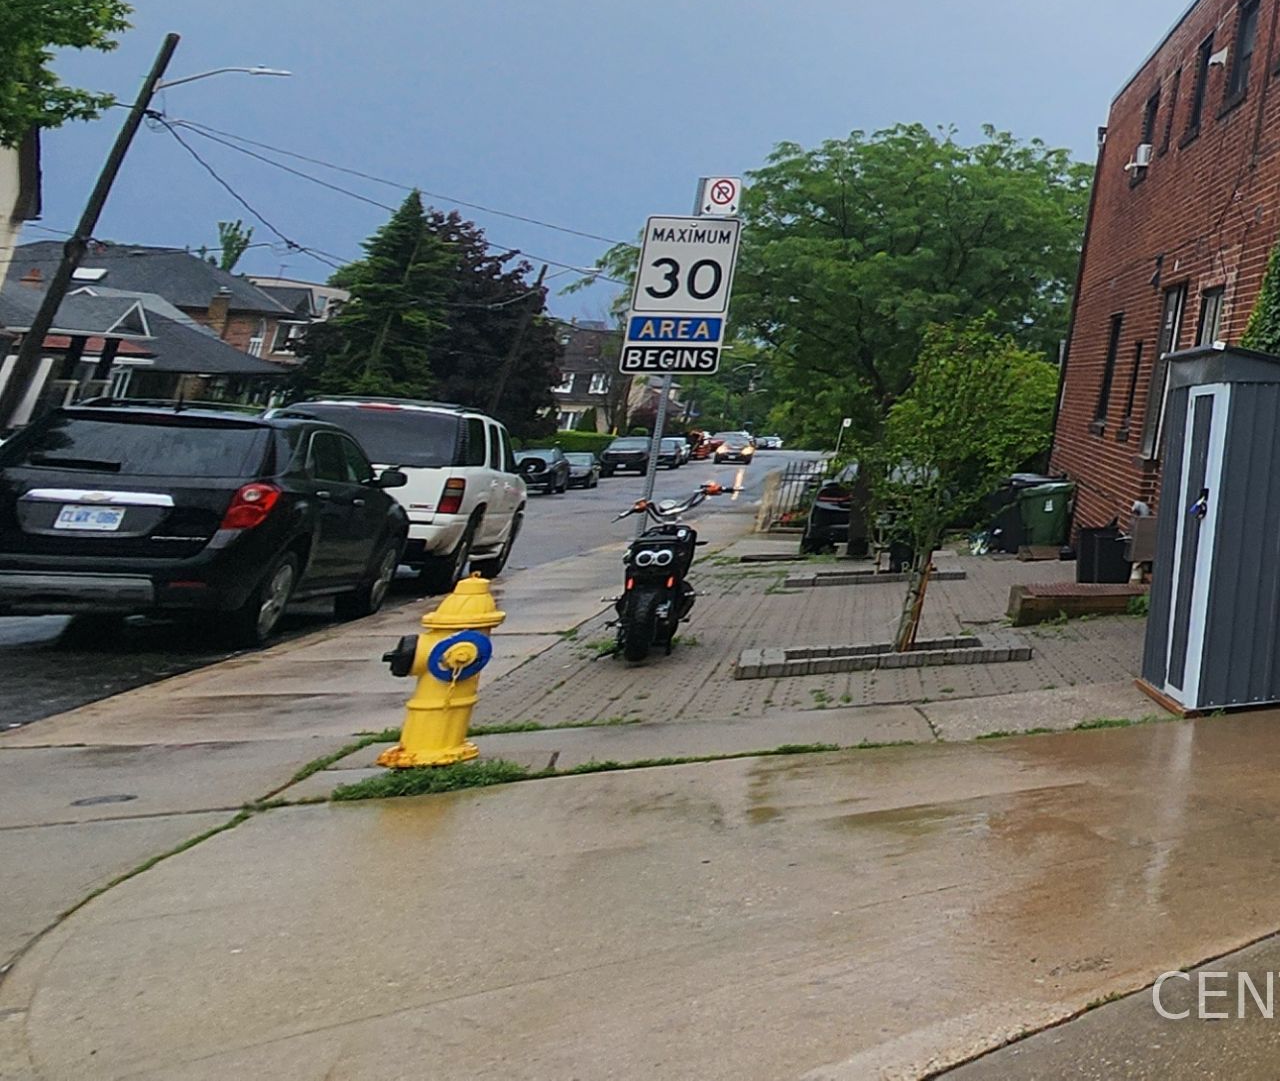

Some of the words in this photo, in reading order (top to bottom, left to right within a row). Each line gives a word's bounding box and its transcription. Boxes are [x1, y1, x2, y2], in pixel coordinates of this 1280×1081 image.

[652, 228, 732, 245] MAXIMUM
[645, 257, 723, 301] 30
[638, 320, 710, 339] AREA
[625, 349, 715, 369] BEGINS
